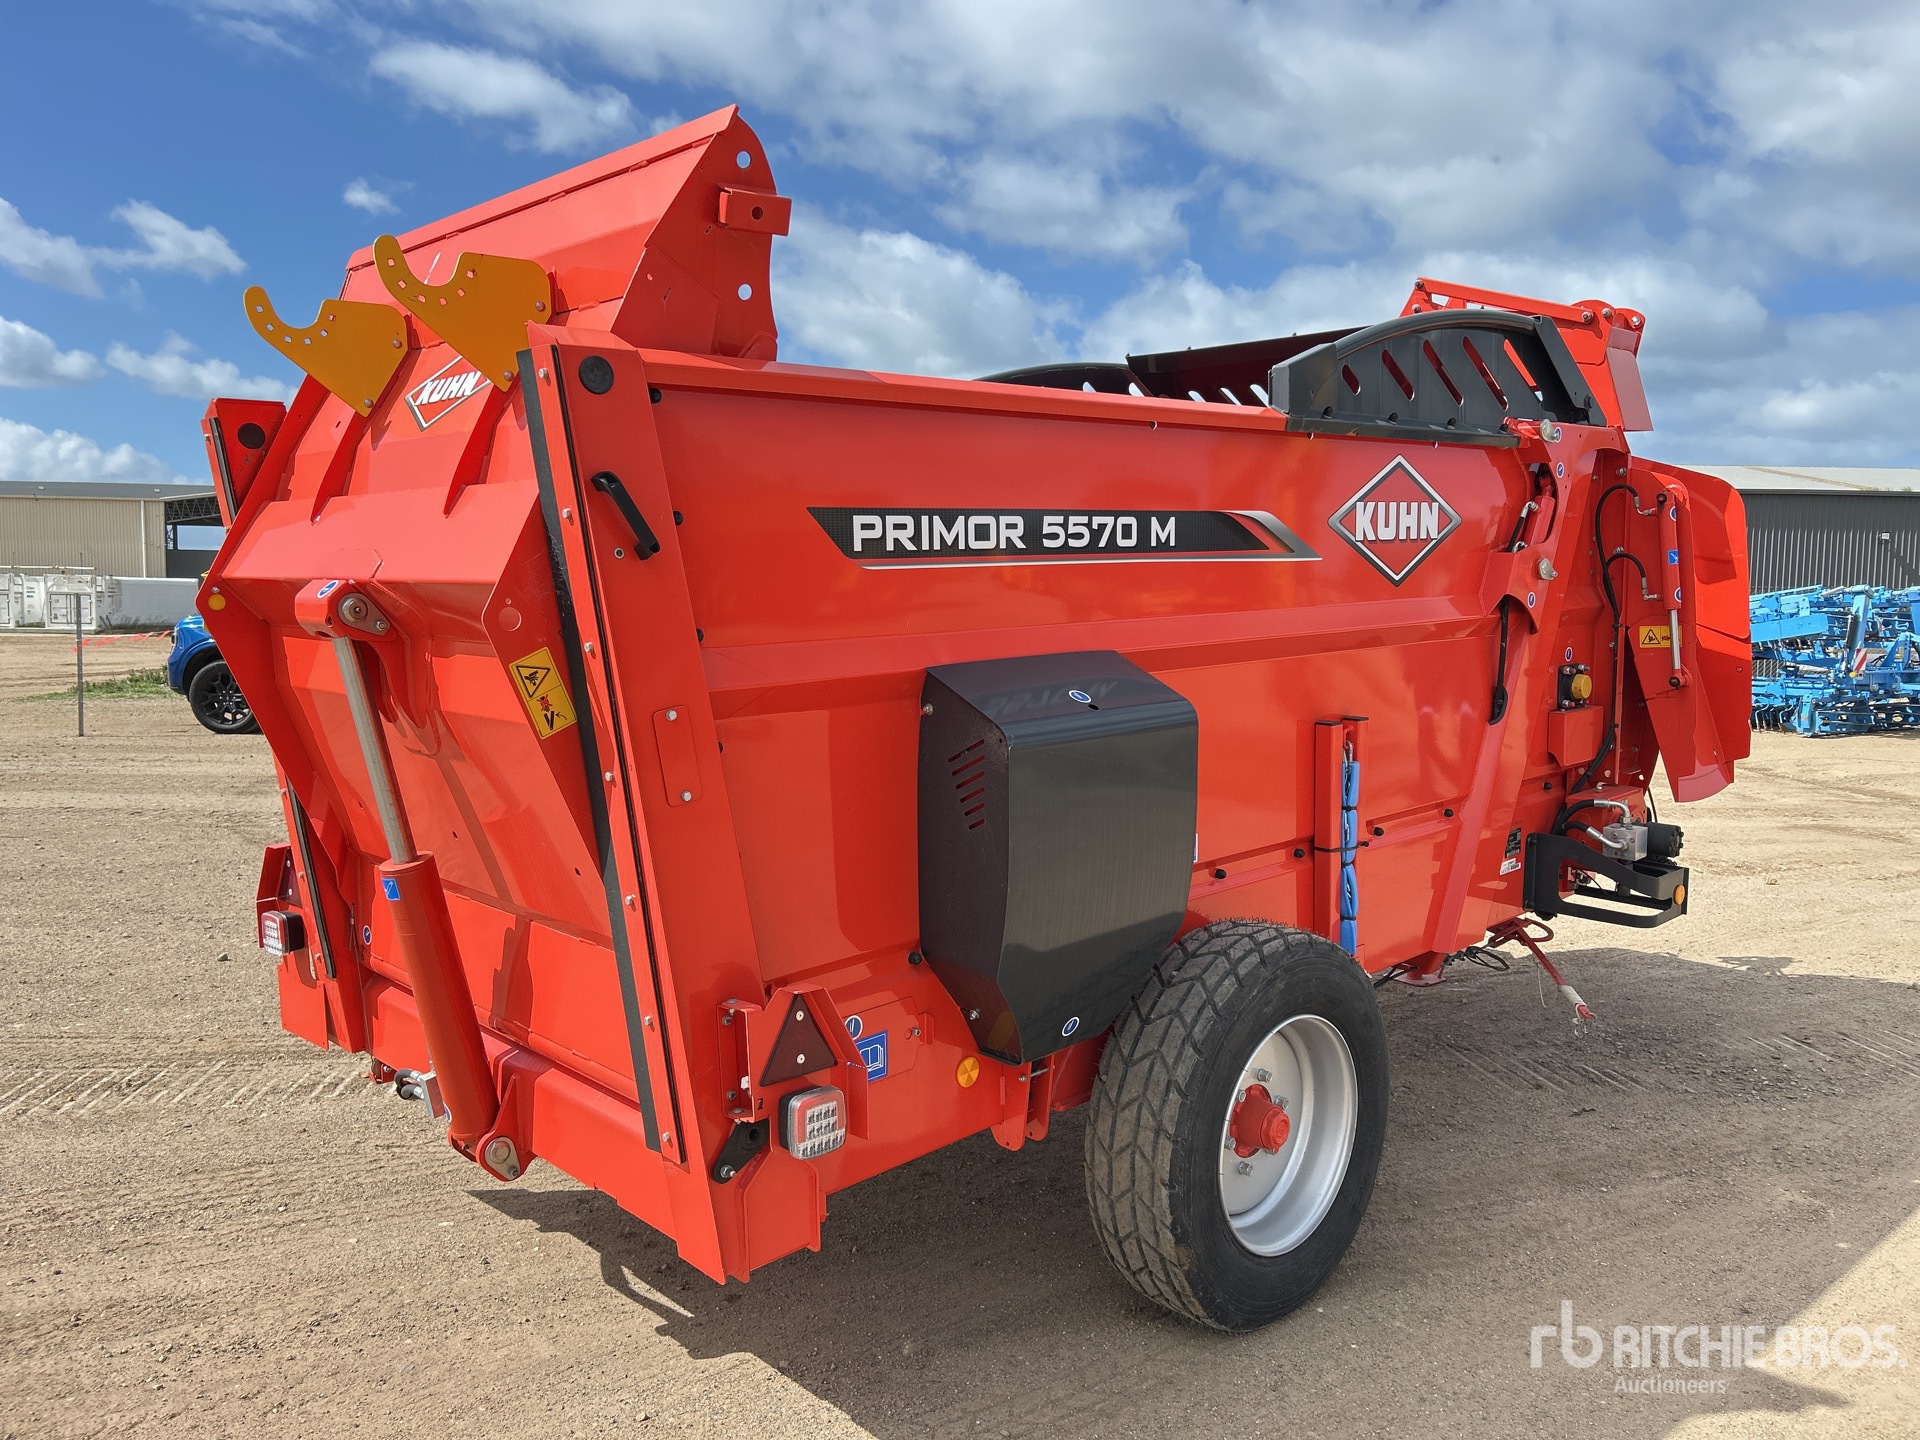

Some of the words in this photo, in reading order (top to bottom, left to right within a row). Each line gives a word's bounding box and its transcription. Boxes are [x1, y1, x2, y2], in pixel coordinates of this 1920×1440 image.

[415, 371, 482, 406] KUHN
[852, 515, 1027, 552] PRIMOR
[1042, 515, 1138, 548] 5570
[1150, 516, 1176, 547] M
[1355, 501, 1439, 541] KUHN
